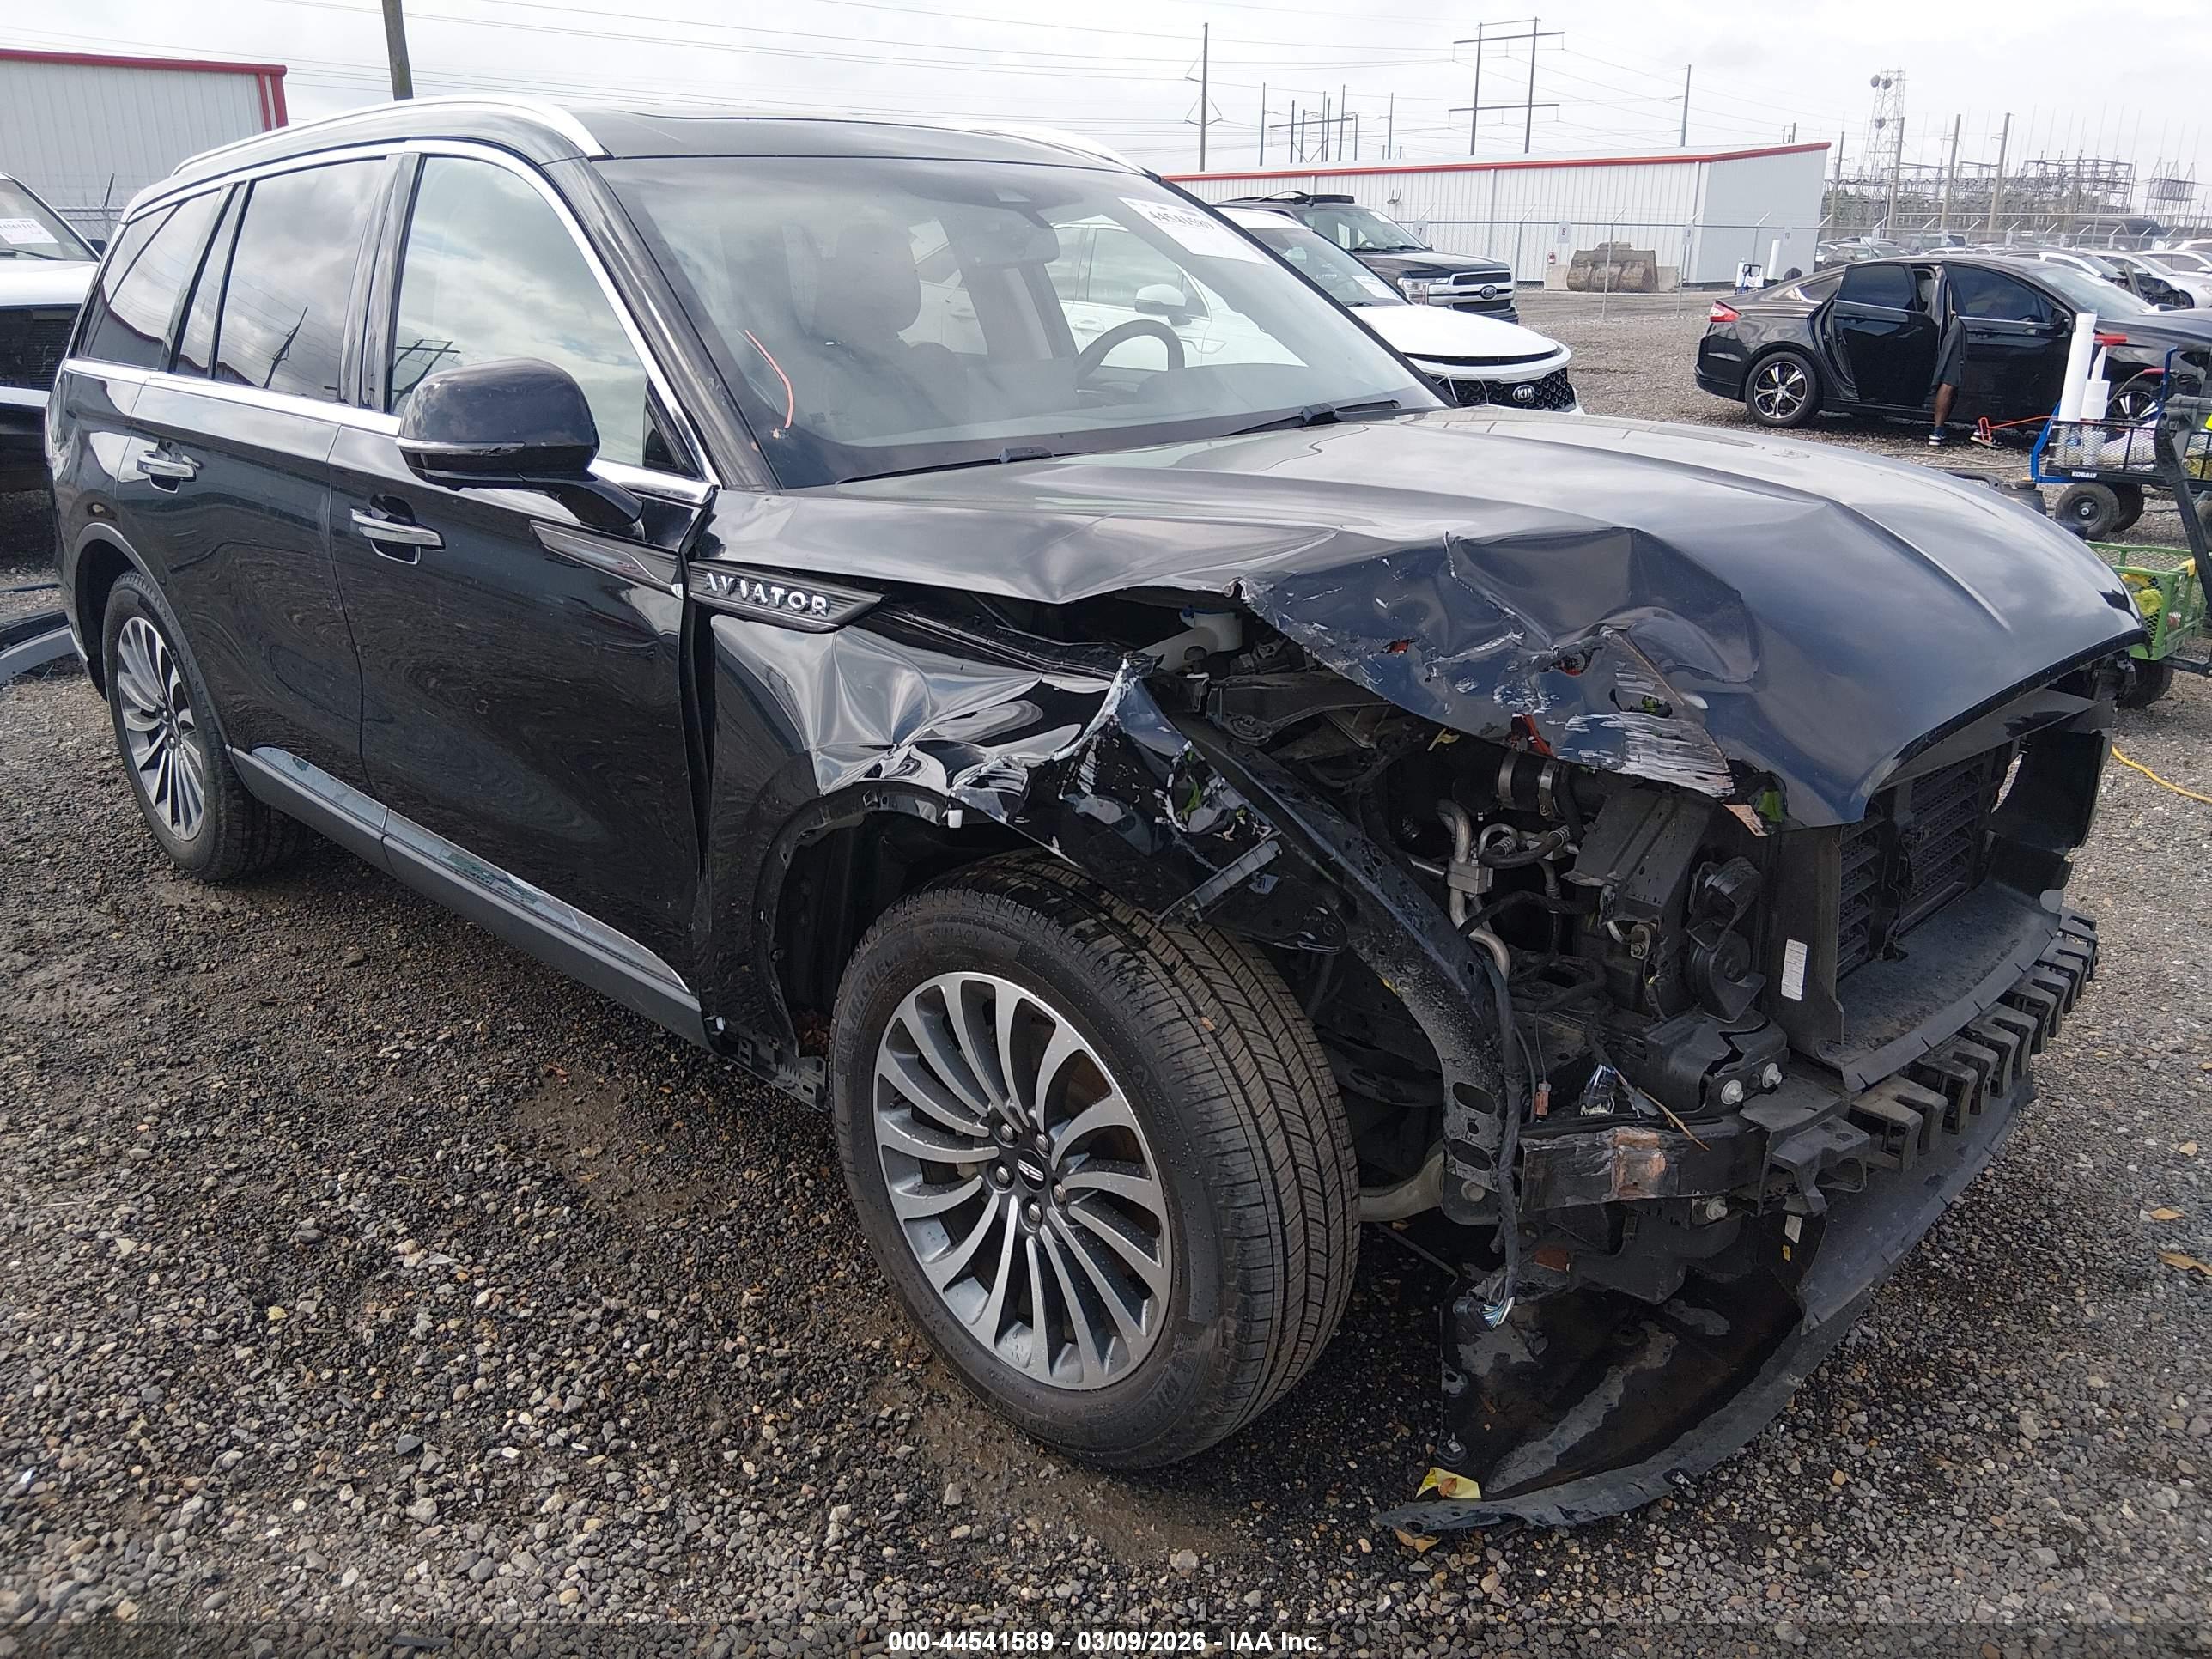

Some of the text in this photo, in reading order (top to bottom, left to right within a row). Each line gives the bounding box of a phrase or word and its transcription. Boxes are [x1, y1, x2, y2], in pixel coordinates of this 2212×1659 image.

[1418, 228, 1423, 237] 7
[1517, 388, 1533, 400] KIA
[704, 571, 831, 617] AVIATOR
